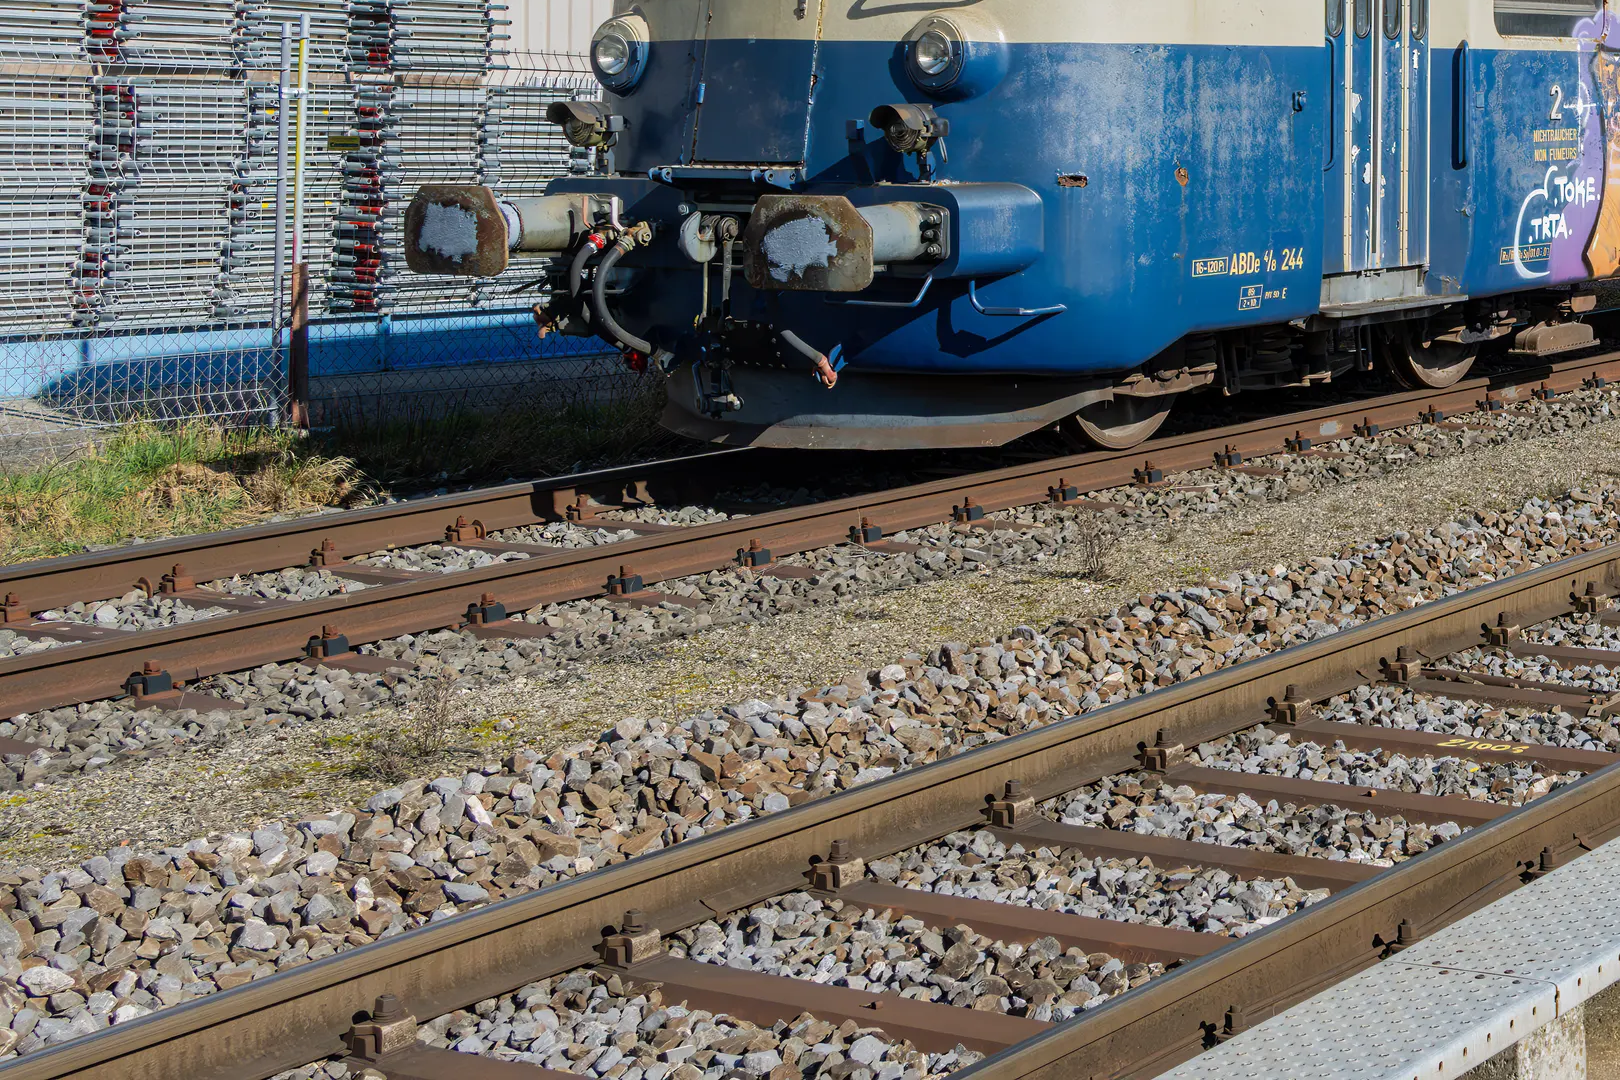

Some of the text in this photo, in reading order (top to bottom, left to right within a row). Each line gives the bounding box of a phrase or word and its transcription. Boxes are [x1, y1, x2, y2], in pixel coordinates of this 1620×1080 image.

[1550, 85, 1562, 120] 2
[1533, 128, 1577, 142] NICHTRAUCHER
[1534, 147, 1577, 161] NON FUMEURS
[1229, 252, 1260, 275] ABDe
[1264, 249, 1277, 272] 4/8
[1281, 247, 1304, 271] 244
